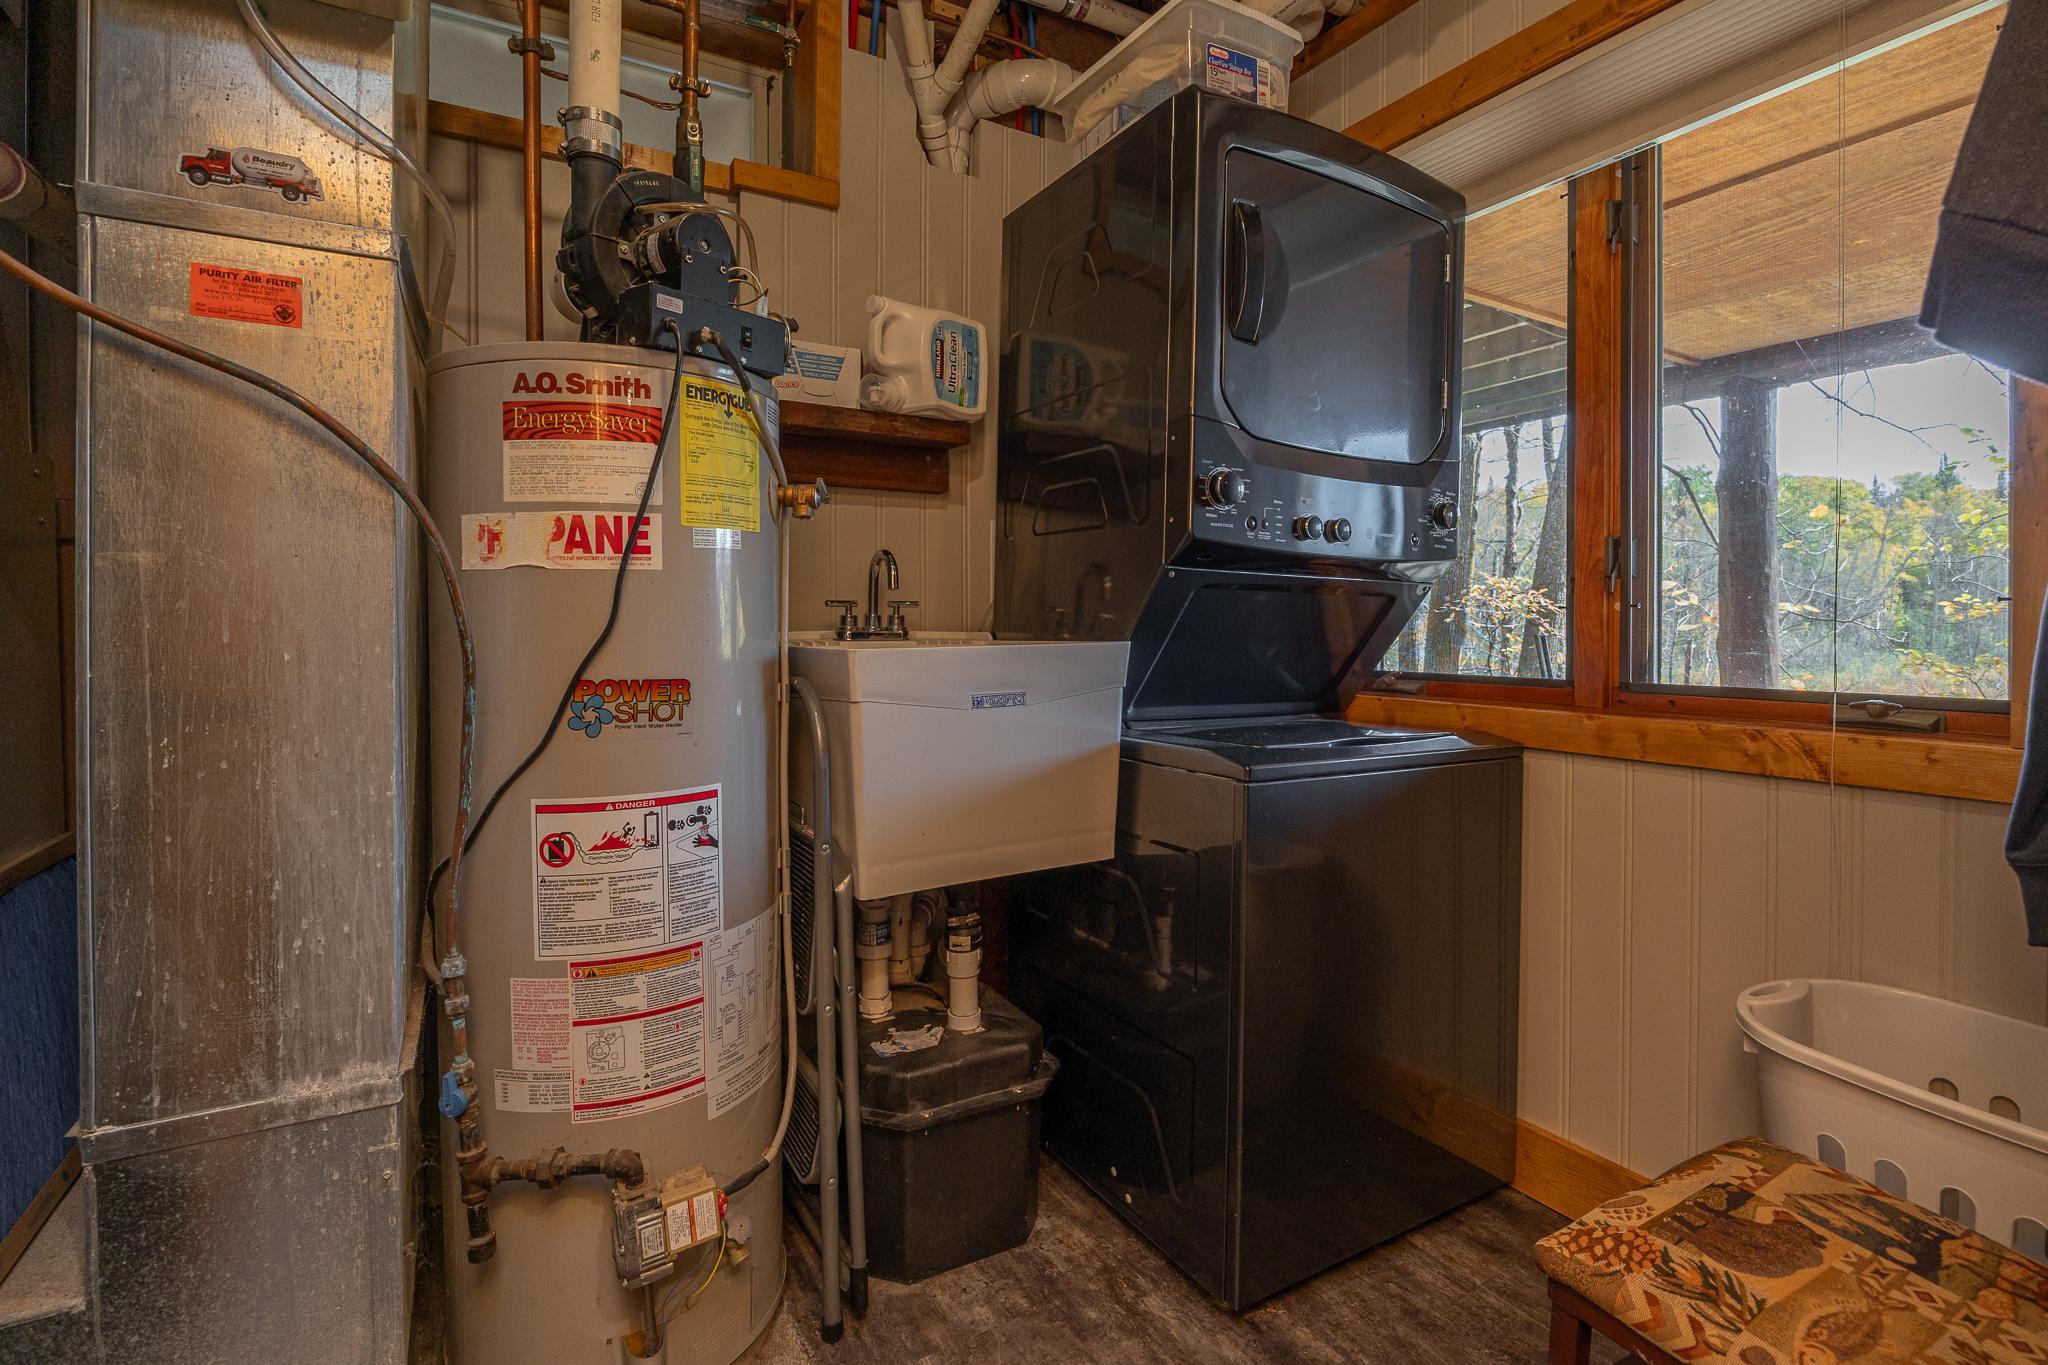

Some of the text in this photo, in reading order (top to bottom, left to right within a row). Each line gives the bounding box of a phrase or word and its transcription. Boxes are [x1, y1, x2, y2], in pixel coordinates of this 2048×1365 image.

[252, 155, 296, 171] Beaudry
[200, 267, 298, 289] PURITY AIR FILTER
[948, 331, 957, 393] UltraClean
[686, 385, 752, 413] ENERGYGUI
[513, 407, 651, 434] EnergySaver
[574, 679, 691, 703] POWER
[614, 701, 690, 723] SHOT
[616, 800, 656, 810] DANGER
